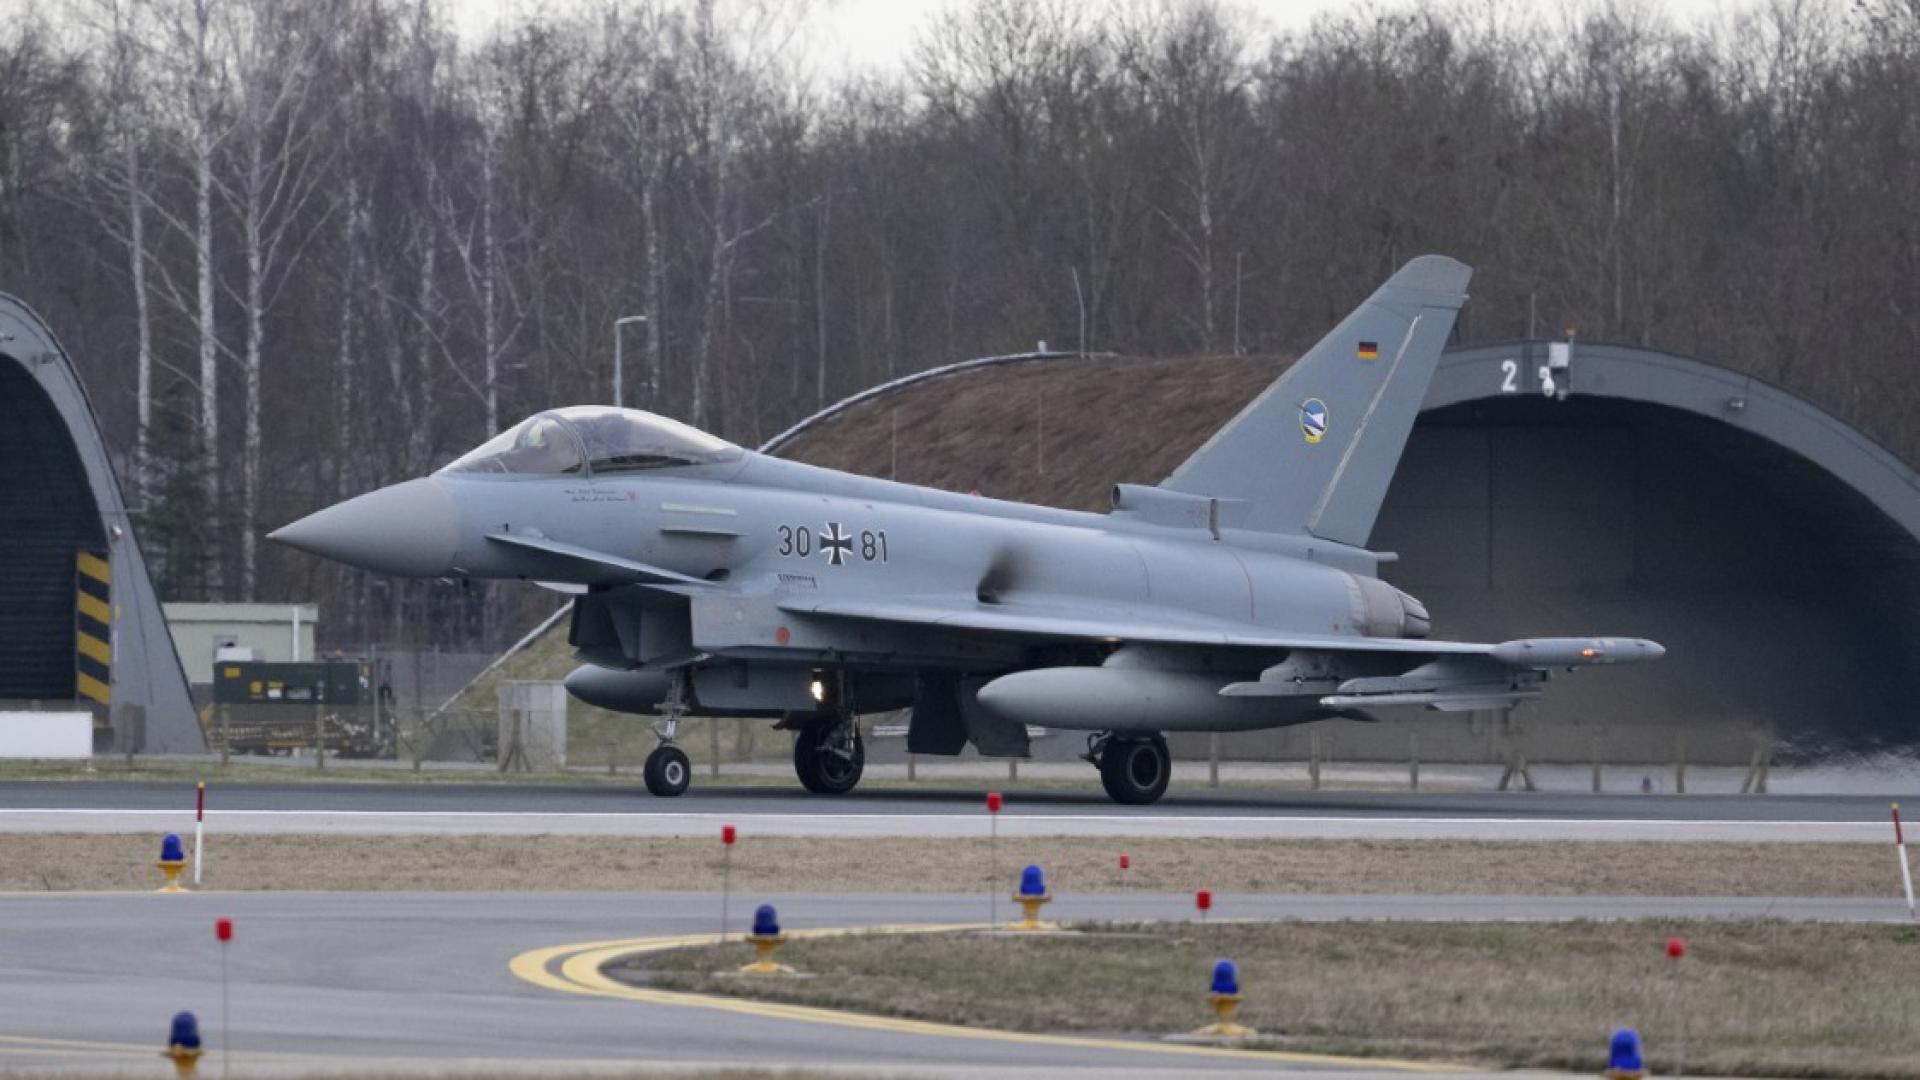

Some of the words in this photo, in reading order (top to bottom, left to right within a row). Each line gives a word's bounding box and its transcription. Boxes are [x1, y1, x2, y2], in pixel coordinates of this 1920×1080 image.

[1501, 359, 1517, 392] 2
[778, 525, 810, 557] 30
[861, 530, 887, 562] 81
